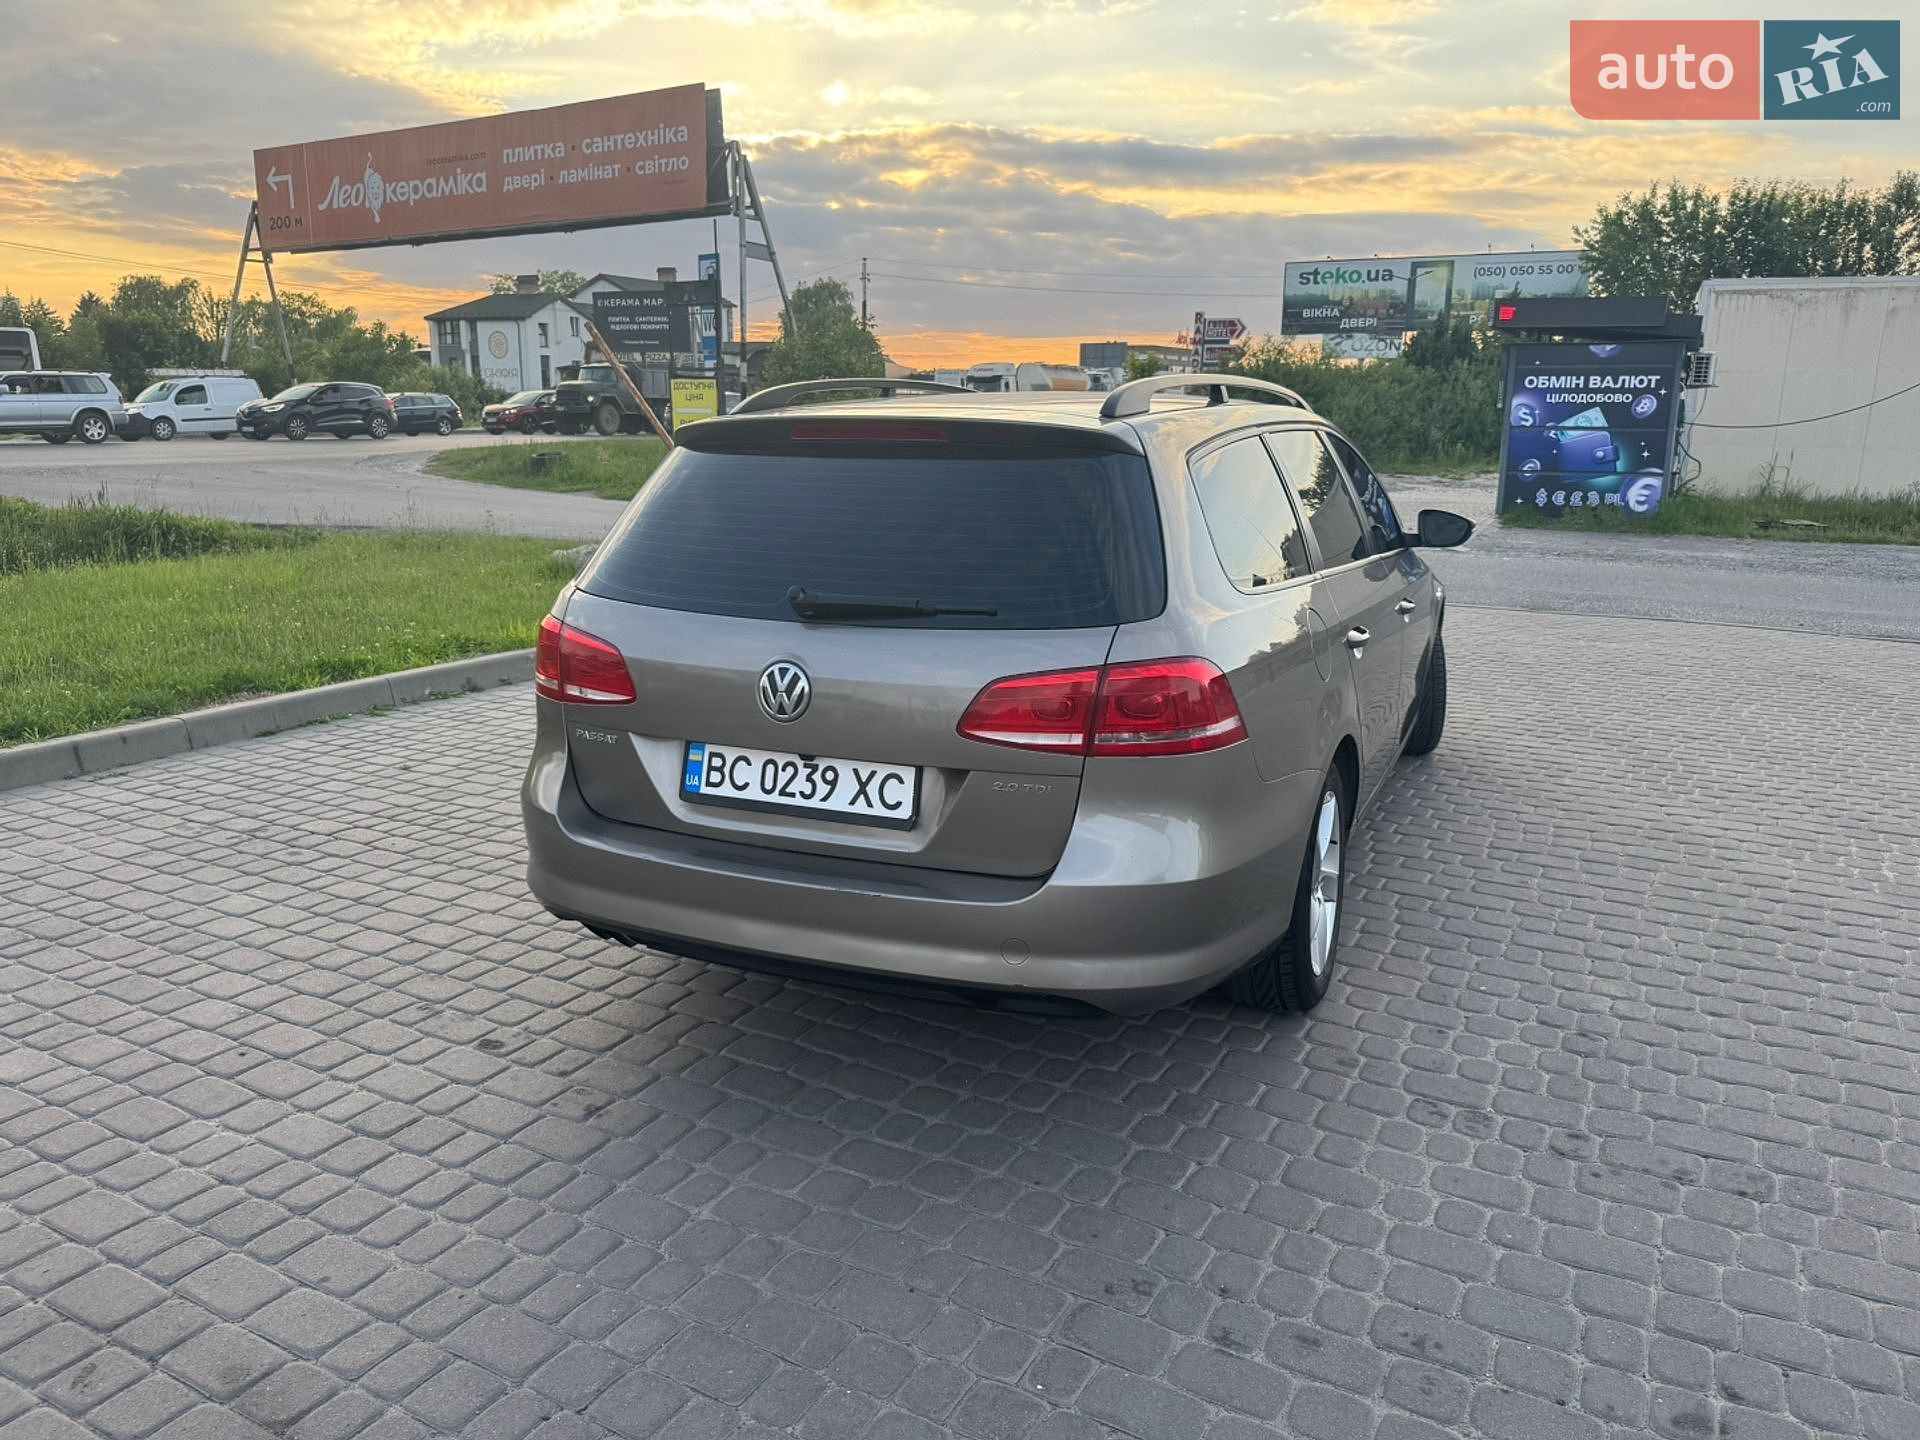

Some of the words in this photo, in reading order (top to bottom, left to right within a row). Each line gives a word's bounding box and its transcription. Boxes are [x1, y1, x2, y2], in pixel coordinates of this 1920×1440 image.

[503, 141, 565, 165] плитка
[582, 123, 688, 155] сантехніка
[503, 169, 545, 192] двері
[558, 162, 622, 184] ламінат
[635, 155, 689, 176] світло
[269, 215, 291, 231] 200
[1299, 267, 1394, 286] steko.ua
[1473, 265, 1506, 279] (050)
[1510, 265, 1534, 276] 050
[1538, 264, 1553, 275] 55
[1302, 307, 1340, 318] ВІКНА
[1340, 317, 1377, 329] ДВЕРІ
[1524, 375, 1584, 389] ОБМІН
[1588, 375, 1660, 389] ВАЛЮТ
[1546, 393, 1633, 404] ЦІЛОДОБОВО
[575, 728, 618, 744] PASSAT
[686, 774, 700, 786] UA
[705, 751, 752, 792] BC
[760, 757, 840, 802] 0239
[848, 767, 905, 811] XC
